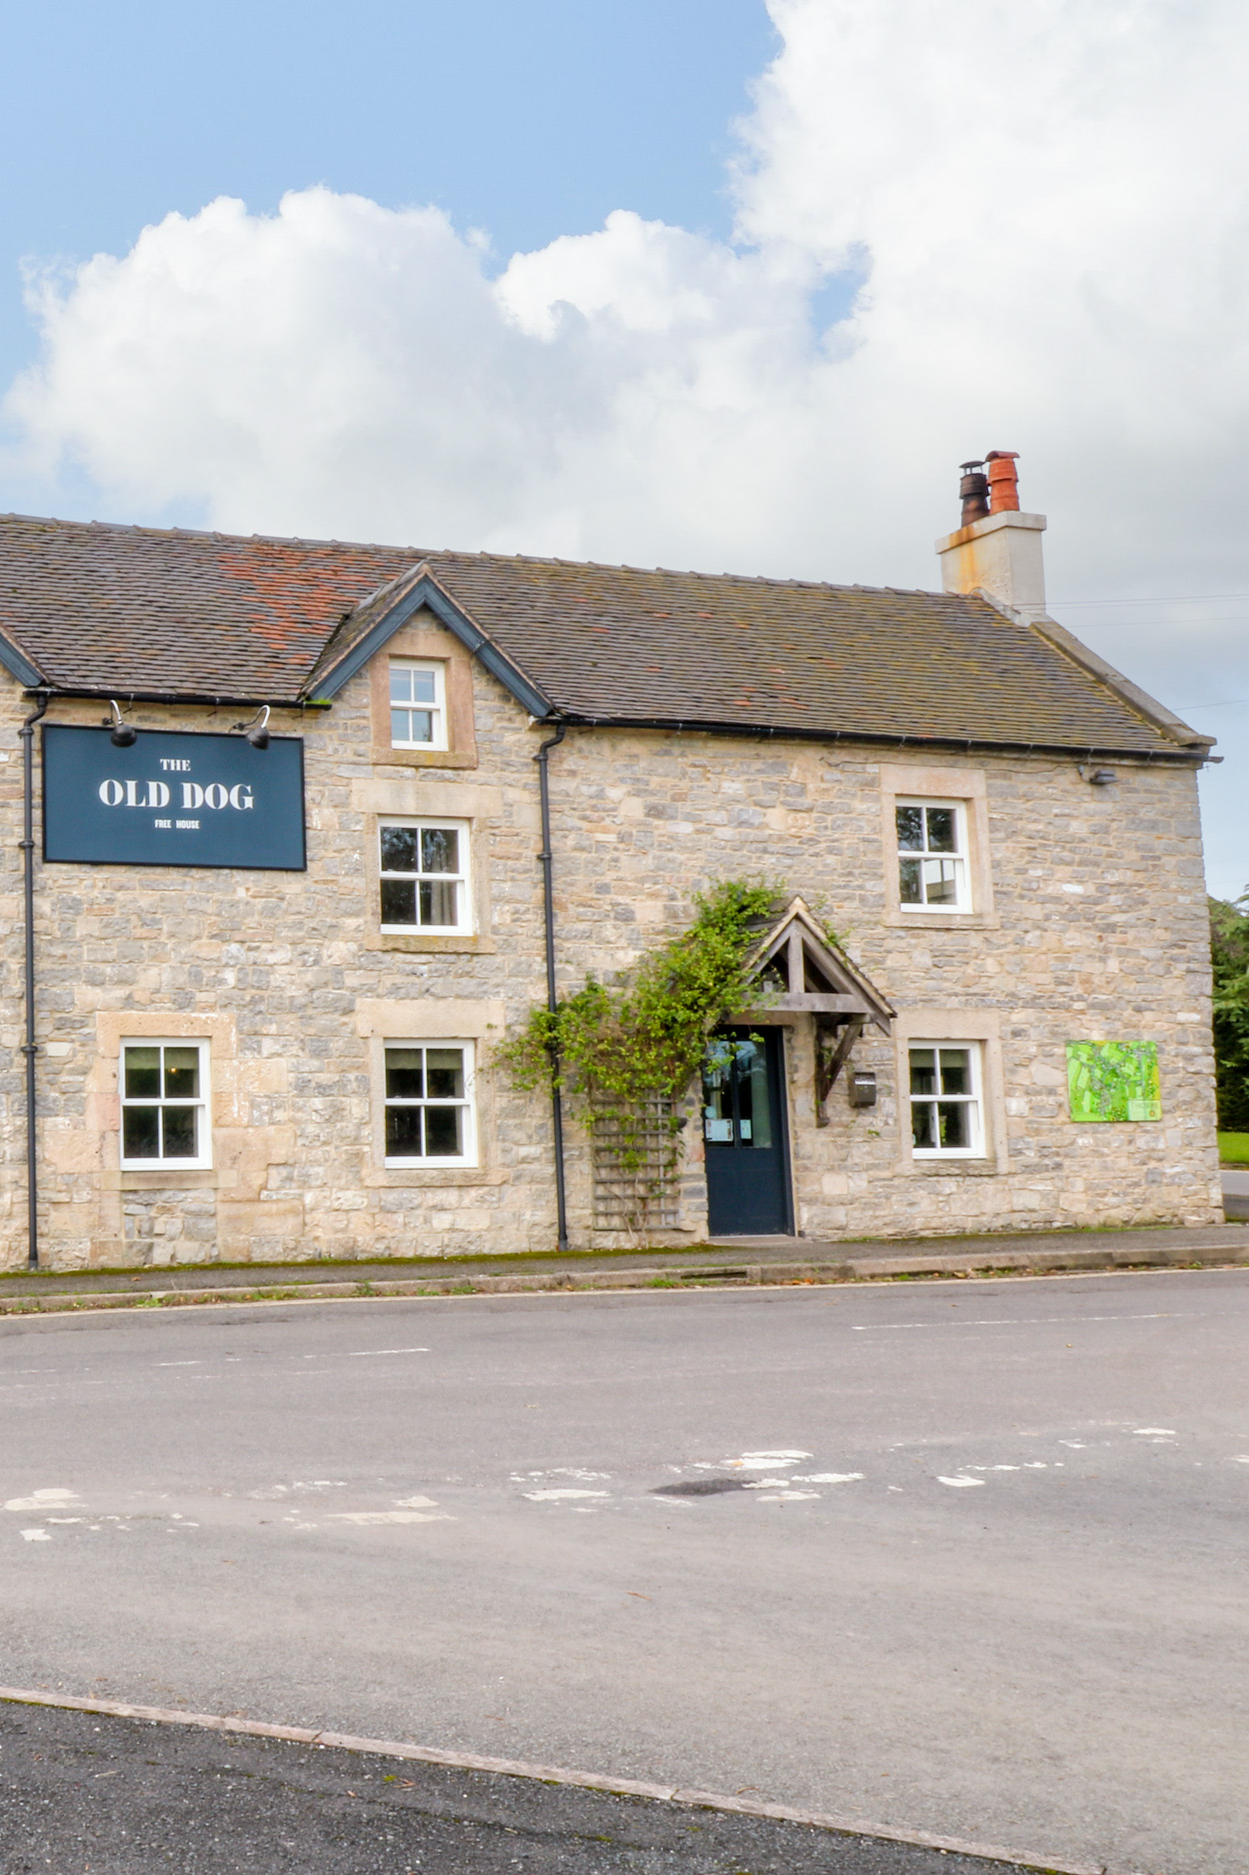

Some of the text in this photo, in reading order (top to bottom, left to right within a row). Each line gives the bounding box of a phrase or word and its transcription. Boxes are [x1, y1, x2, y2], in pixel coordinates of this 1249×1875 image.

[159, 758, 191, 772] THE
[98, 779, 255, 811] OLD DOG
[154, 819, 200, 830] FREE HOUSE
